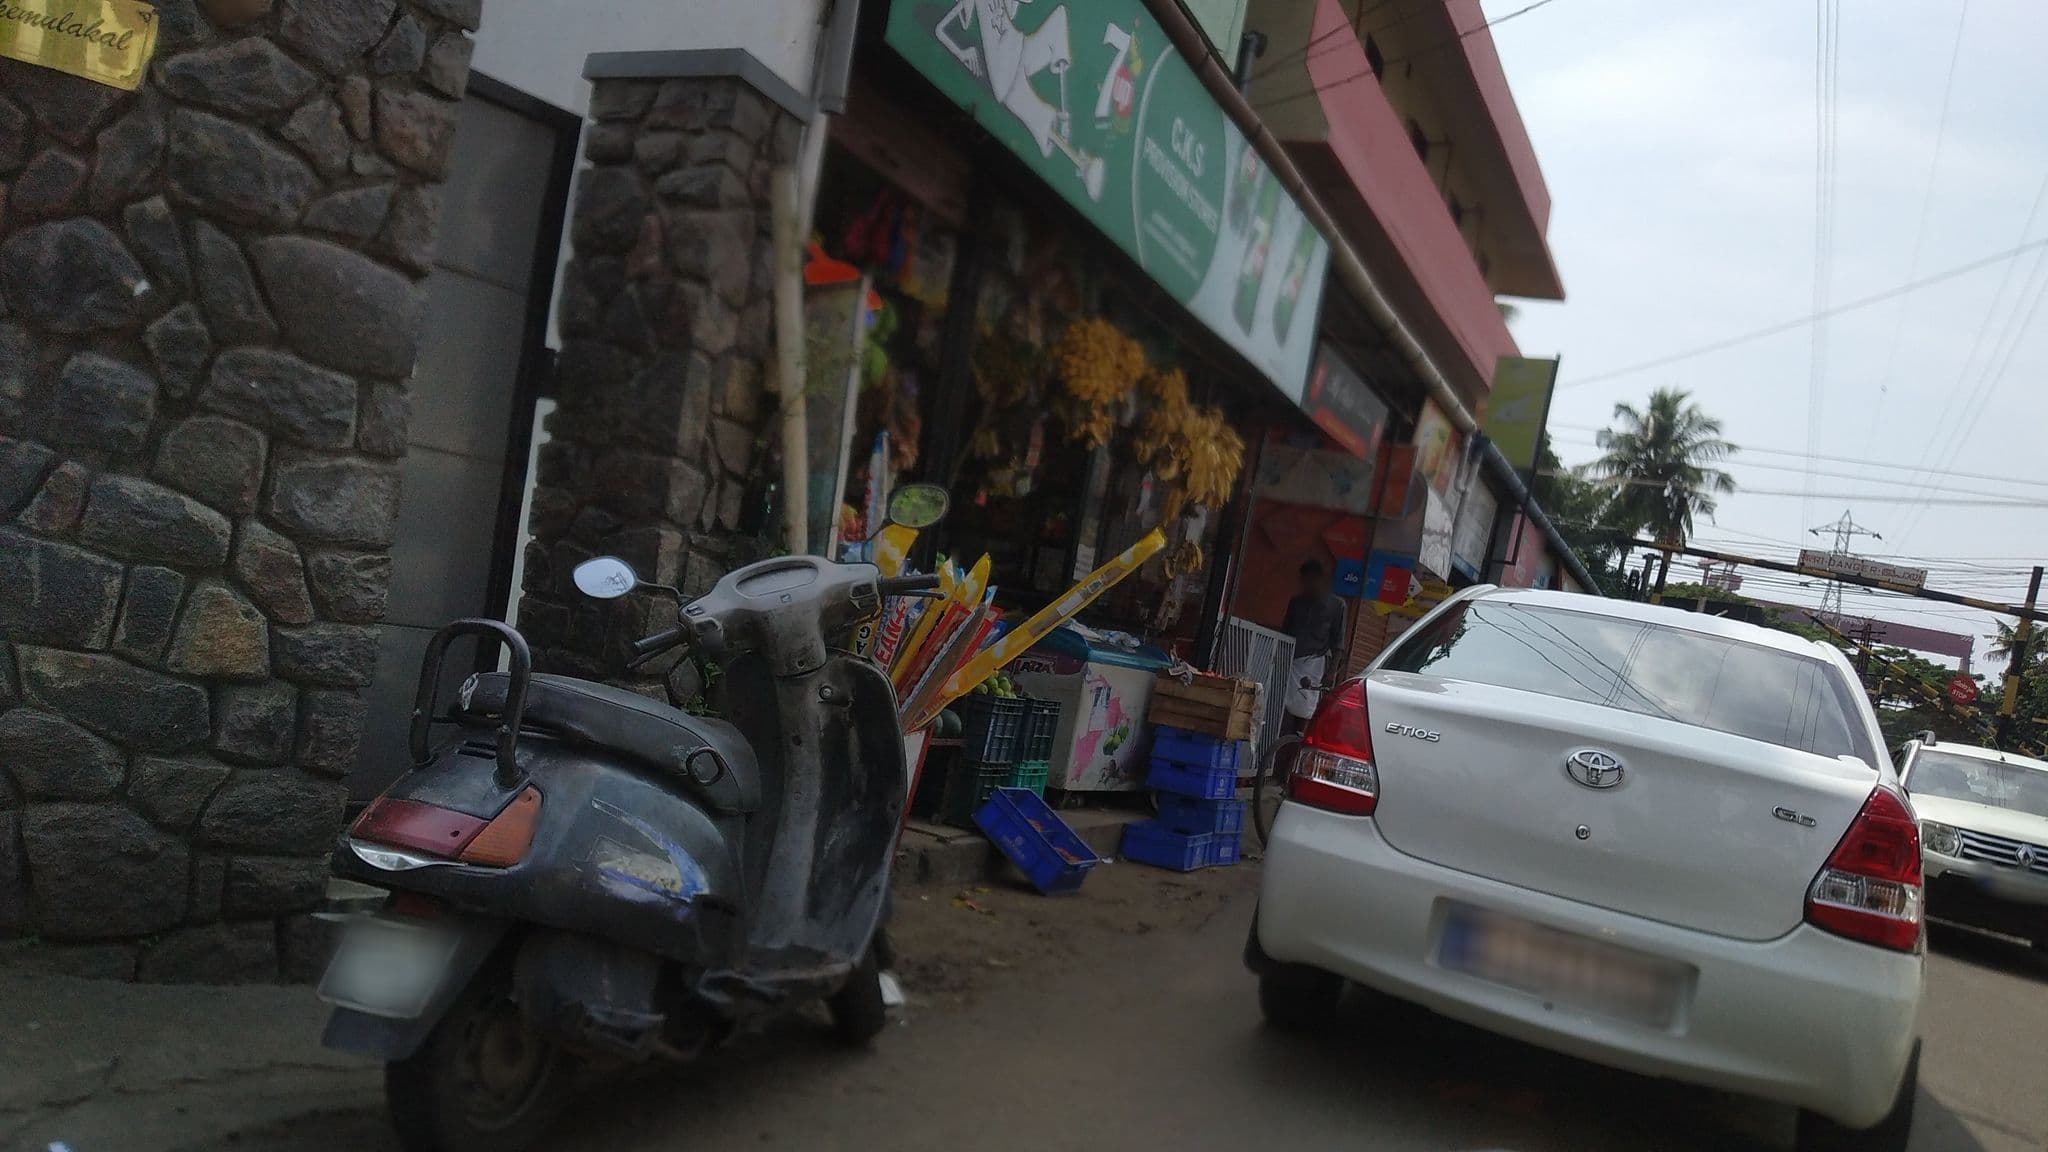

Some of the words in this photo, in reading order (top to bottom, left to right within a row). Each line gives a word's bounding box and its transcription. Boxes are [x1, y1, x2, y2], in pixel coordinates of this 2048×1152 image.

[1828, 557, 1877, 573] DANGER
[1344, 570, 1359, 582] Jio
[1385, 722, 1440, 742] ETIOS
